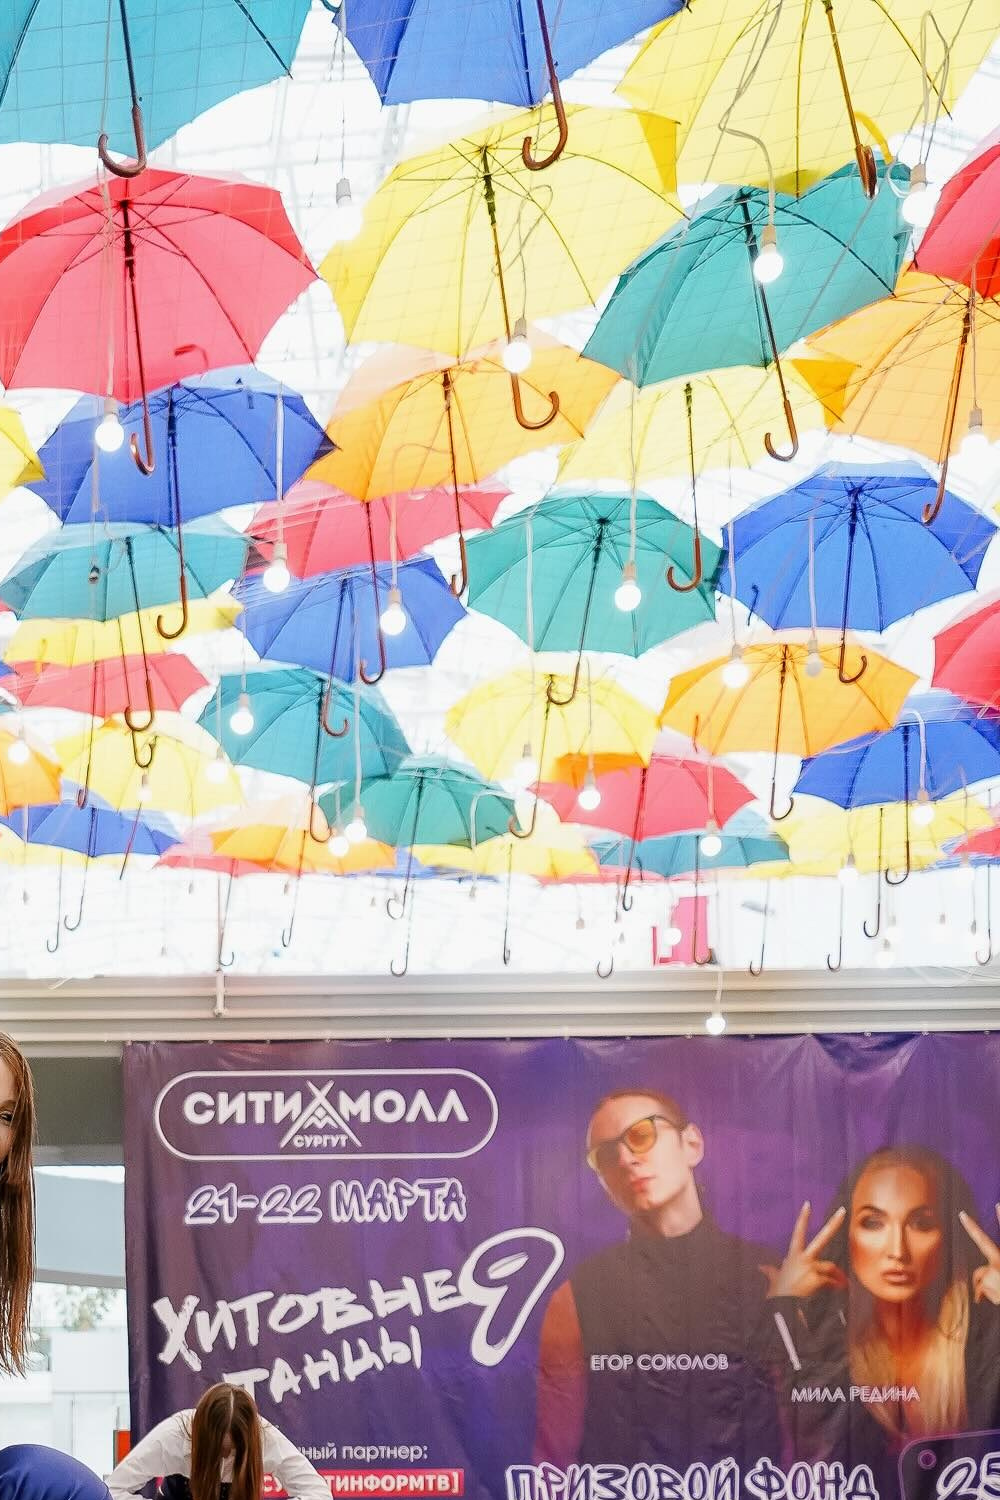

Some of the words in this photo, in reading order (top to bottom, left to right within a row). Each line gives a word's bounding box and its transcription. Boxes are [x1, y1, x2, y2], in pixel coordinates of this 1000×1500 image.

[293, 1134, 348, 1148] СУРГУТ
[185, 1182, 322, 1224] 21-22
[330, 1178, 467, 1223] МАРТА
[152, 1269, 464, 1371] ХИТОВЫЕ
[590, 1355, 633, 1371] ЕГОР
[637, 1354, 729, 1371] СОКОЛОВ
[791, 1386, 846, 1402] МИЛА
[849, 1385, 920, 1404] РЕДИНА
